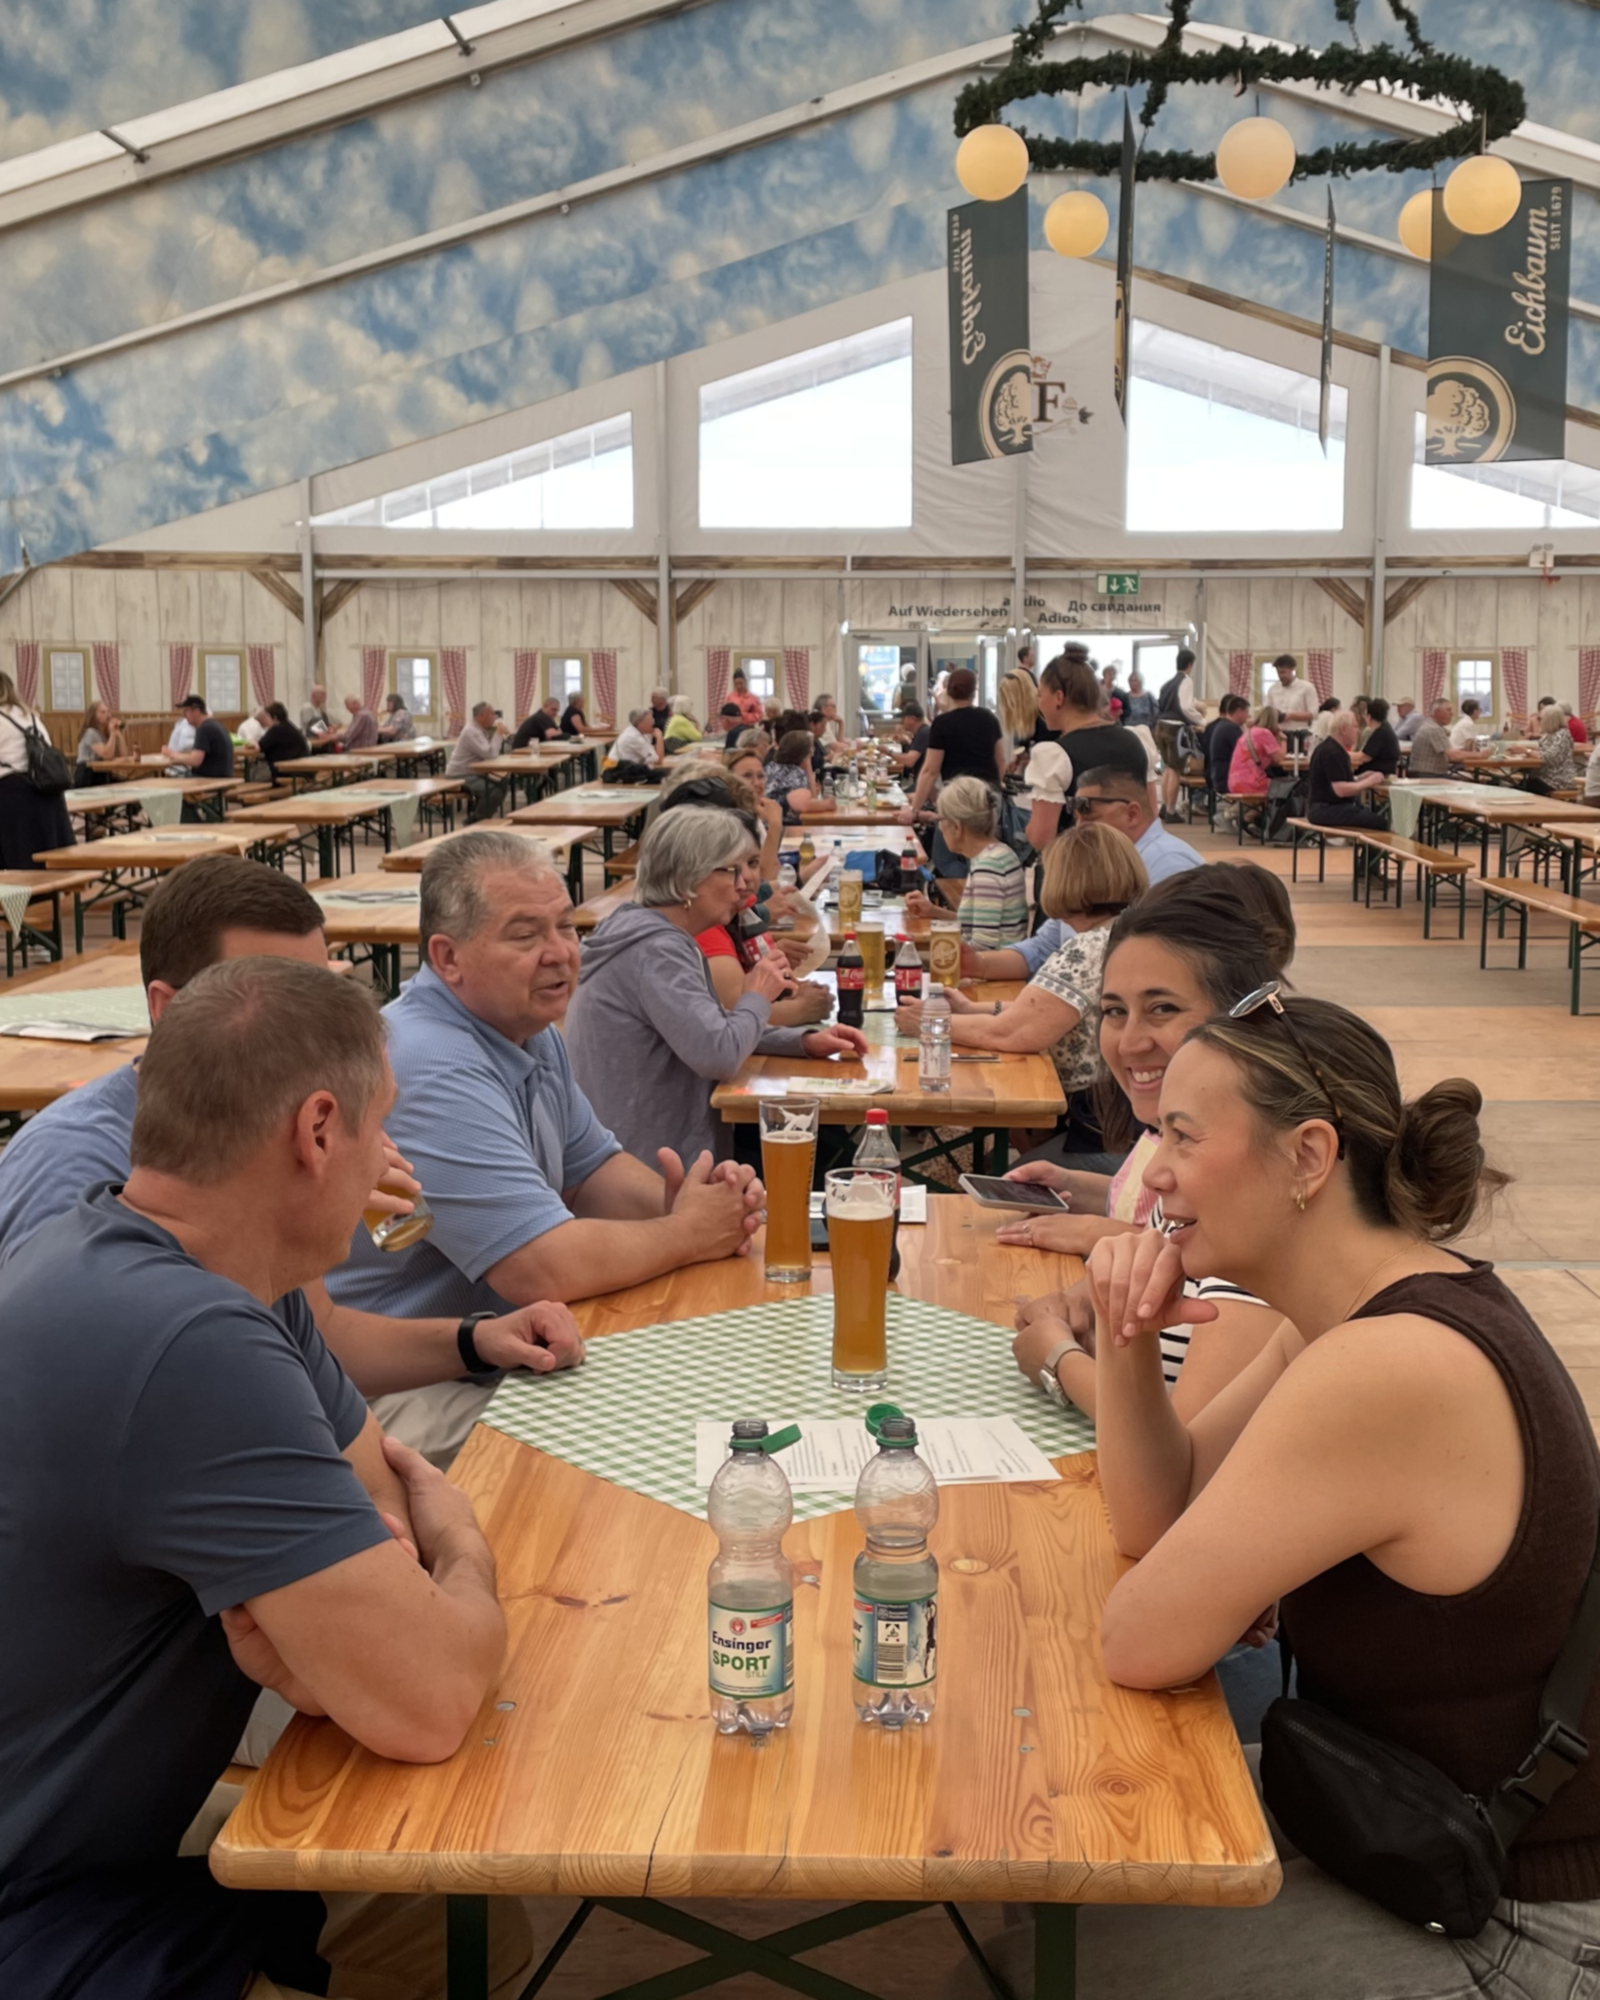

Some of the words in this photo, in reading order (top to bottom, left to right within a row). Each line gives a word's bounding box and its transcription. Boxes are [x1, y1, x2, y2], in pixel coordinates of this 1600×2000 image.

[1550, 186, 1563, 218] 1679
[1549, 222, 1562, 251] SEIT
[1504, 206, 1548, 356] Eichbaum
[1033, 381, 1066, 423] F
[888, 605, 913, 617] Auf
[915, 605, 1008, 617] Wiedersehen
[1038, 612, 1078, 624] Adios
[1068, 600, 1088, 613] До
[712, 1630, 772, 1654] Ensinger
[712, 1649, 771, 1671] SPORT
